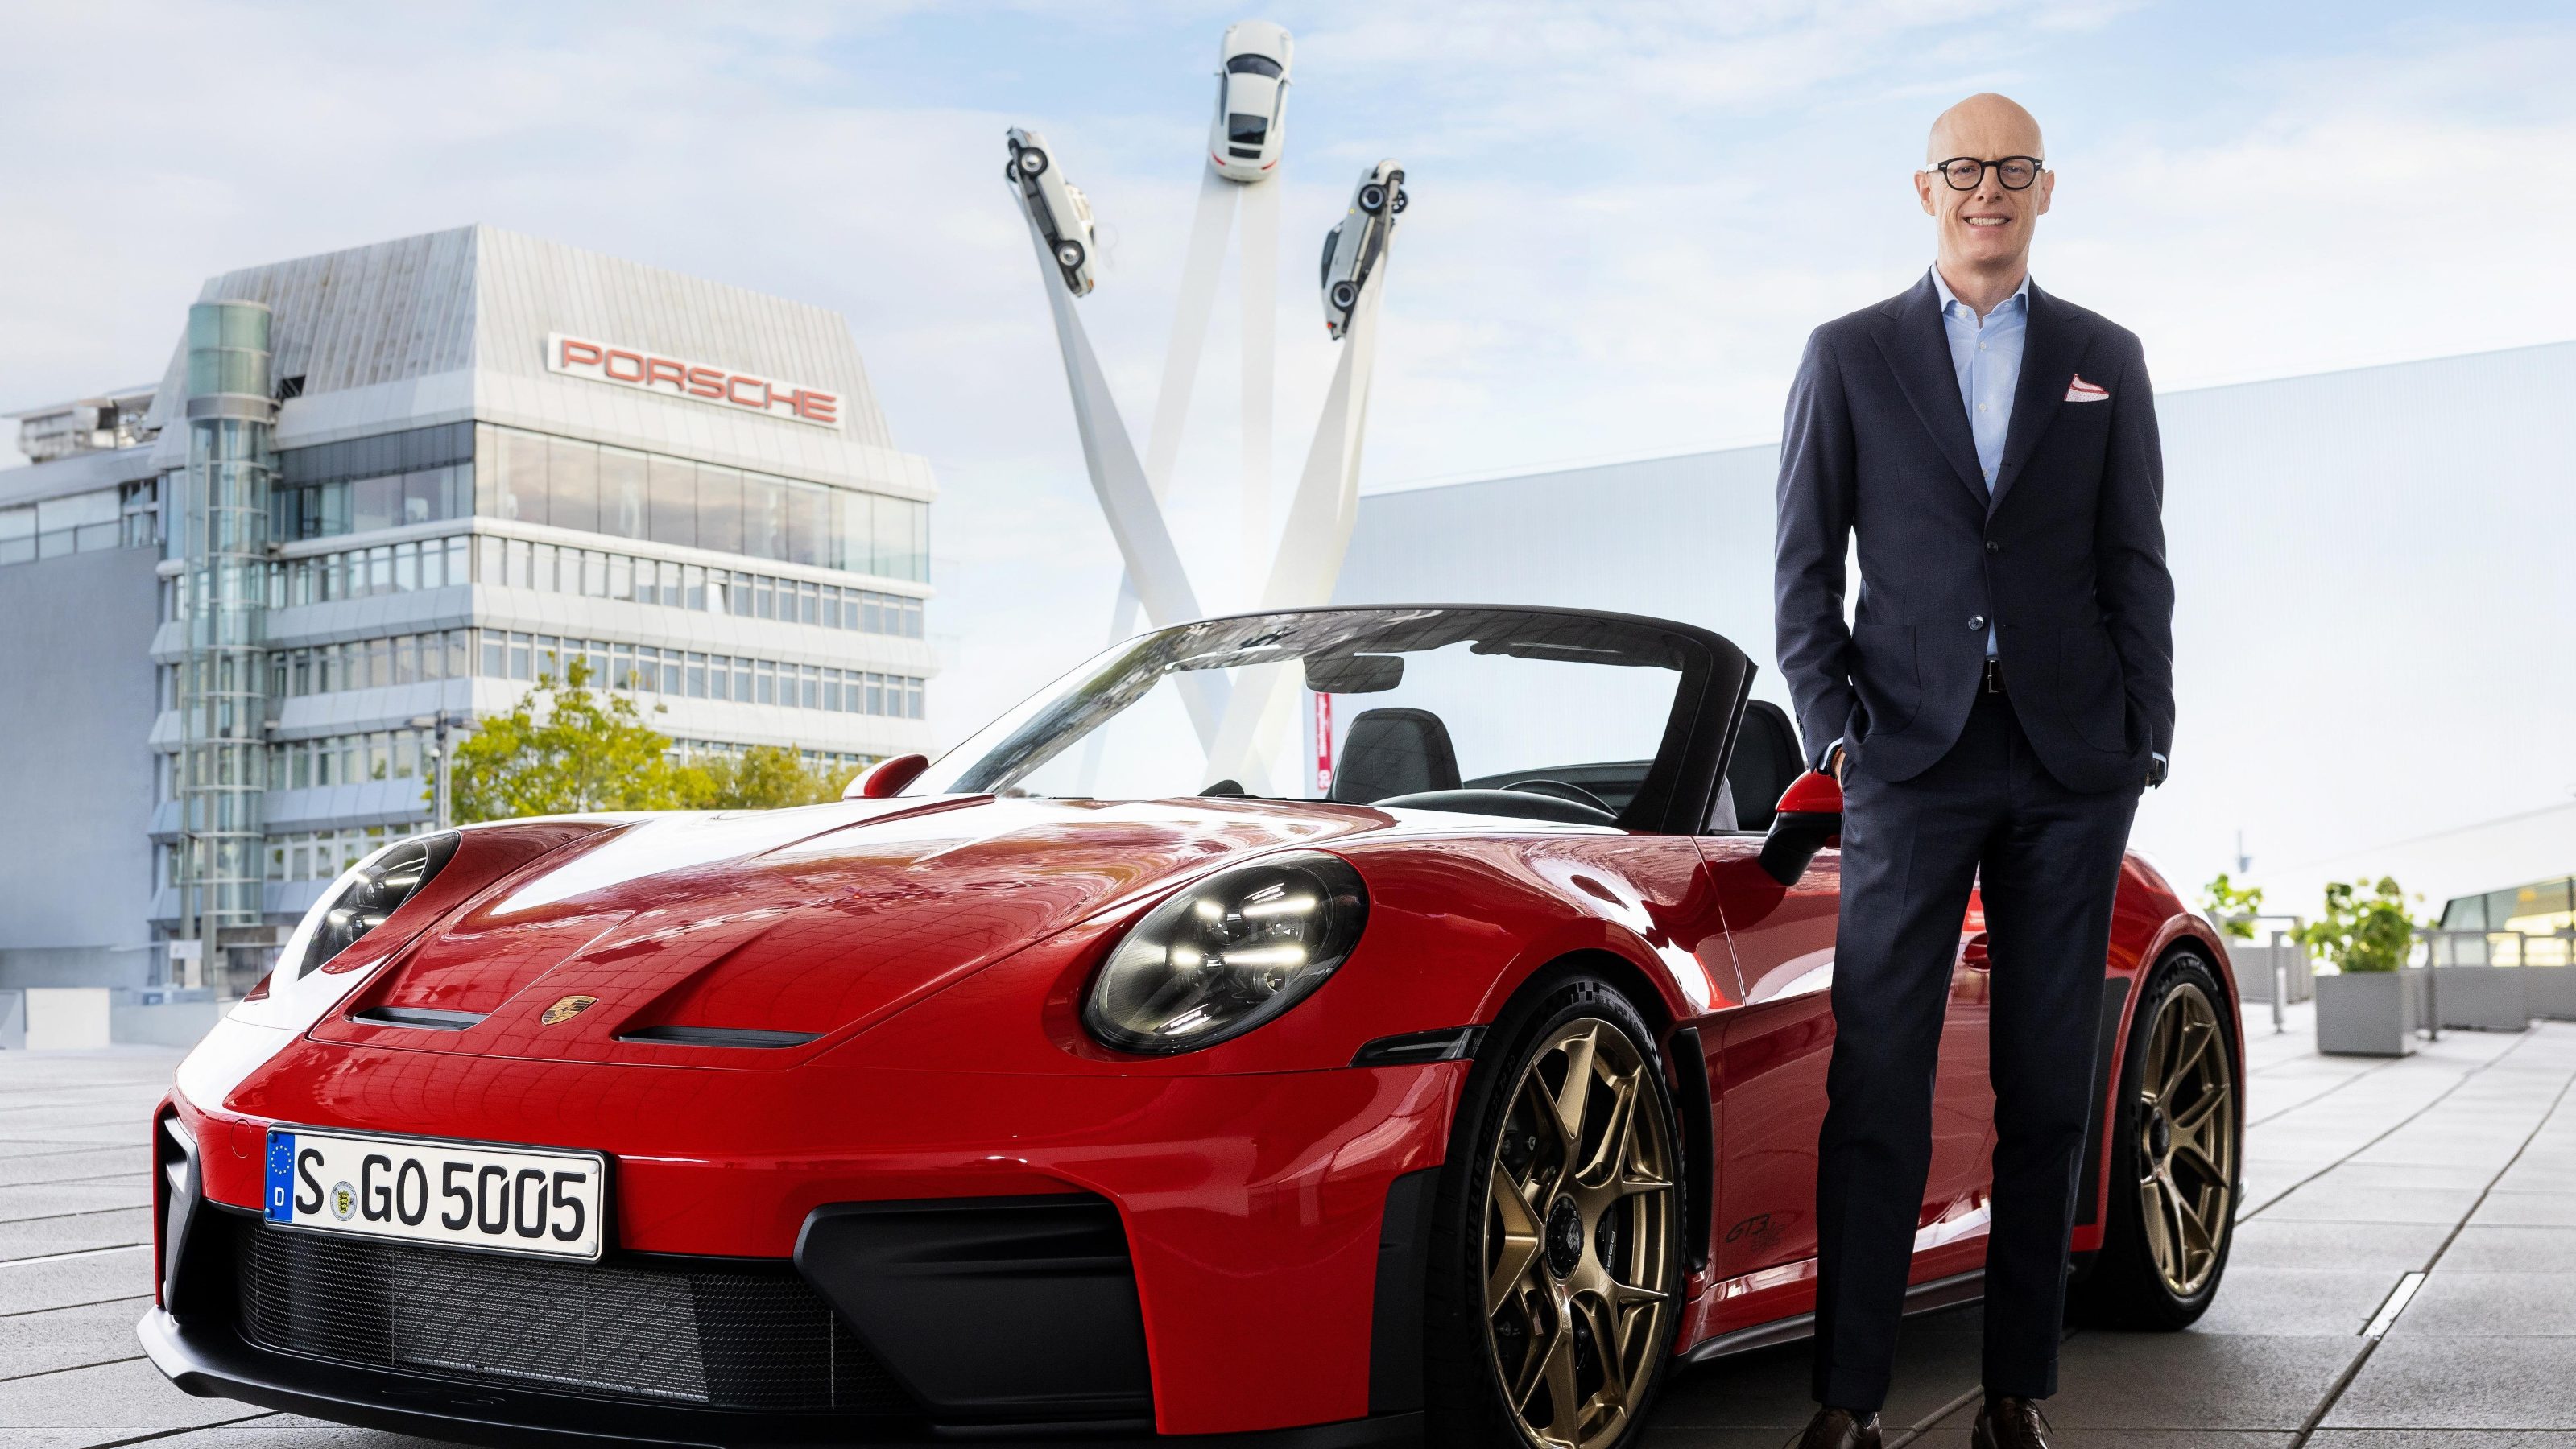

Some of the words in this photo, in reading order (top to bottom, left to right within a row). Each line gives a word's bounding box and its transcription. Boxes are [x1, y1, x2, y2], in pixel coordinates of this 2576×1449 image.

[561, 339, 837, 423] PORSCHE
[274, 1187, 285, 1207] D
[295, 1148, 325, 1215] S
[361, 1154, 428, 1226] GO
[441, 1161, 586, 1242] 5005
[1725, 1212, 1772, 1244] GT3
